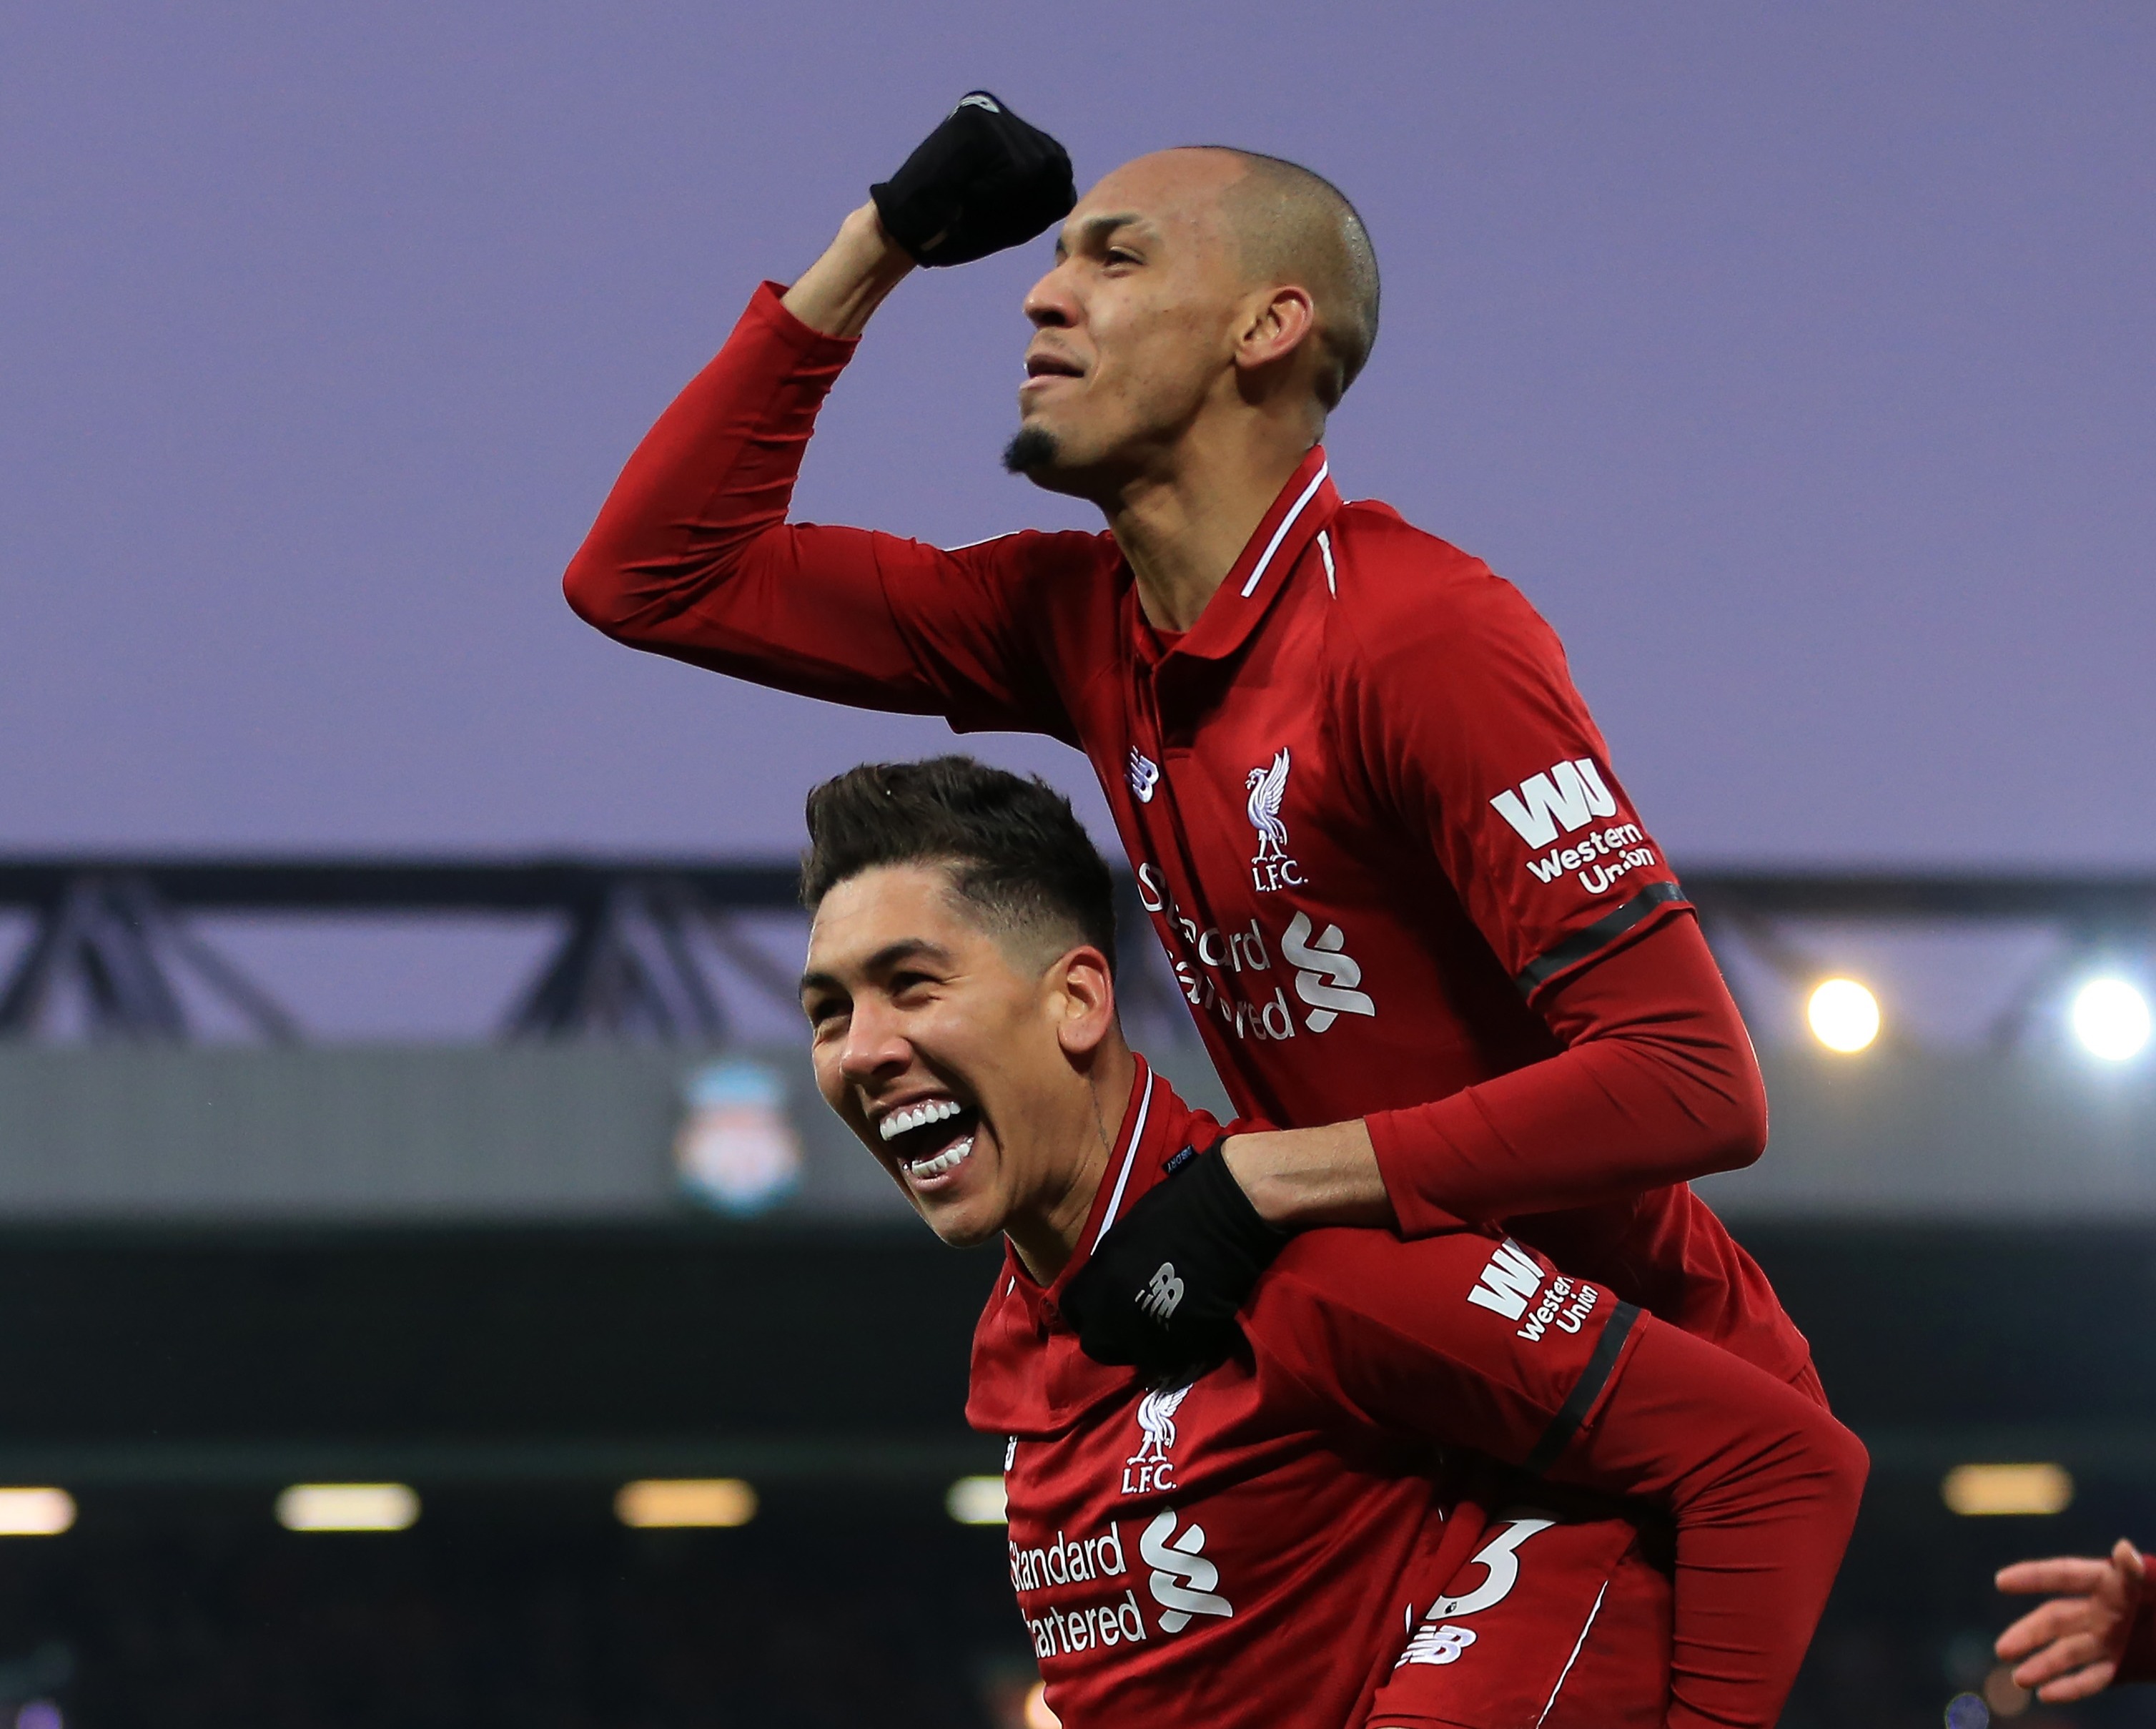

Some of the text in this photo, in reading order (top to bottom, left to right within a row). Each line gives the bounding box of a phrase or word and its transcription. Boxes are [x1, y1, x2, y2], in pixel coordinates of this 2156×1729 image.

[1489, 758, 1617, 849] WU
[1251, 860, 1309, 892] L.F.C.
[1526, 824, 1643, 883] Western
[1578, 848, 1655, 894] Union
[1556, 1285, 1598, 1333] Union
[1121, 1463, 1177, 1494] L.F.C.
[1425, 1519, 1556, 1620] 3
